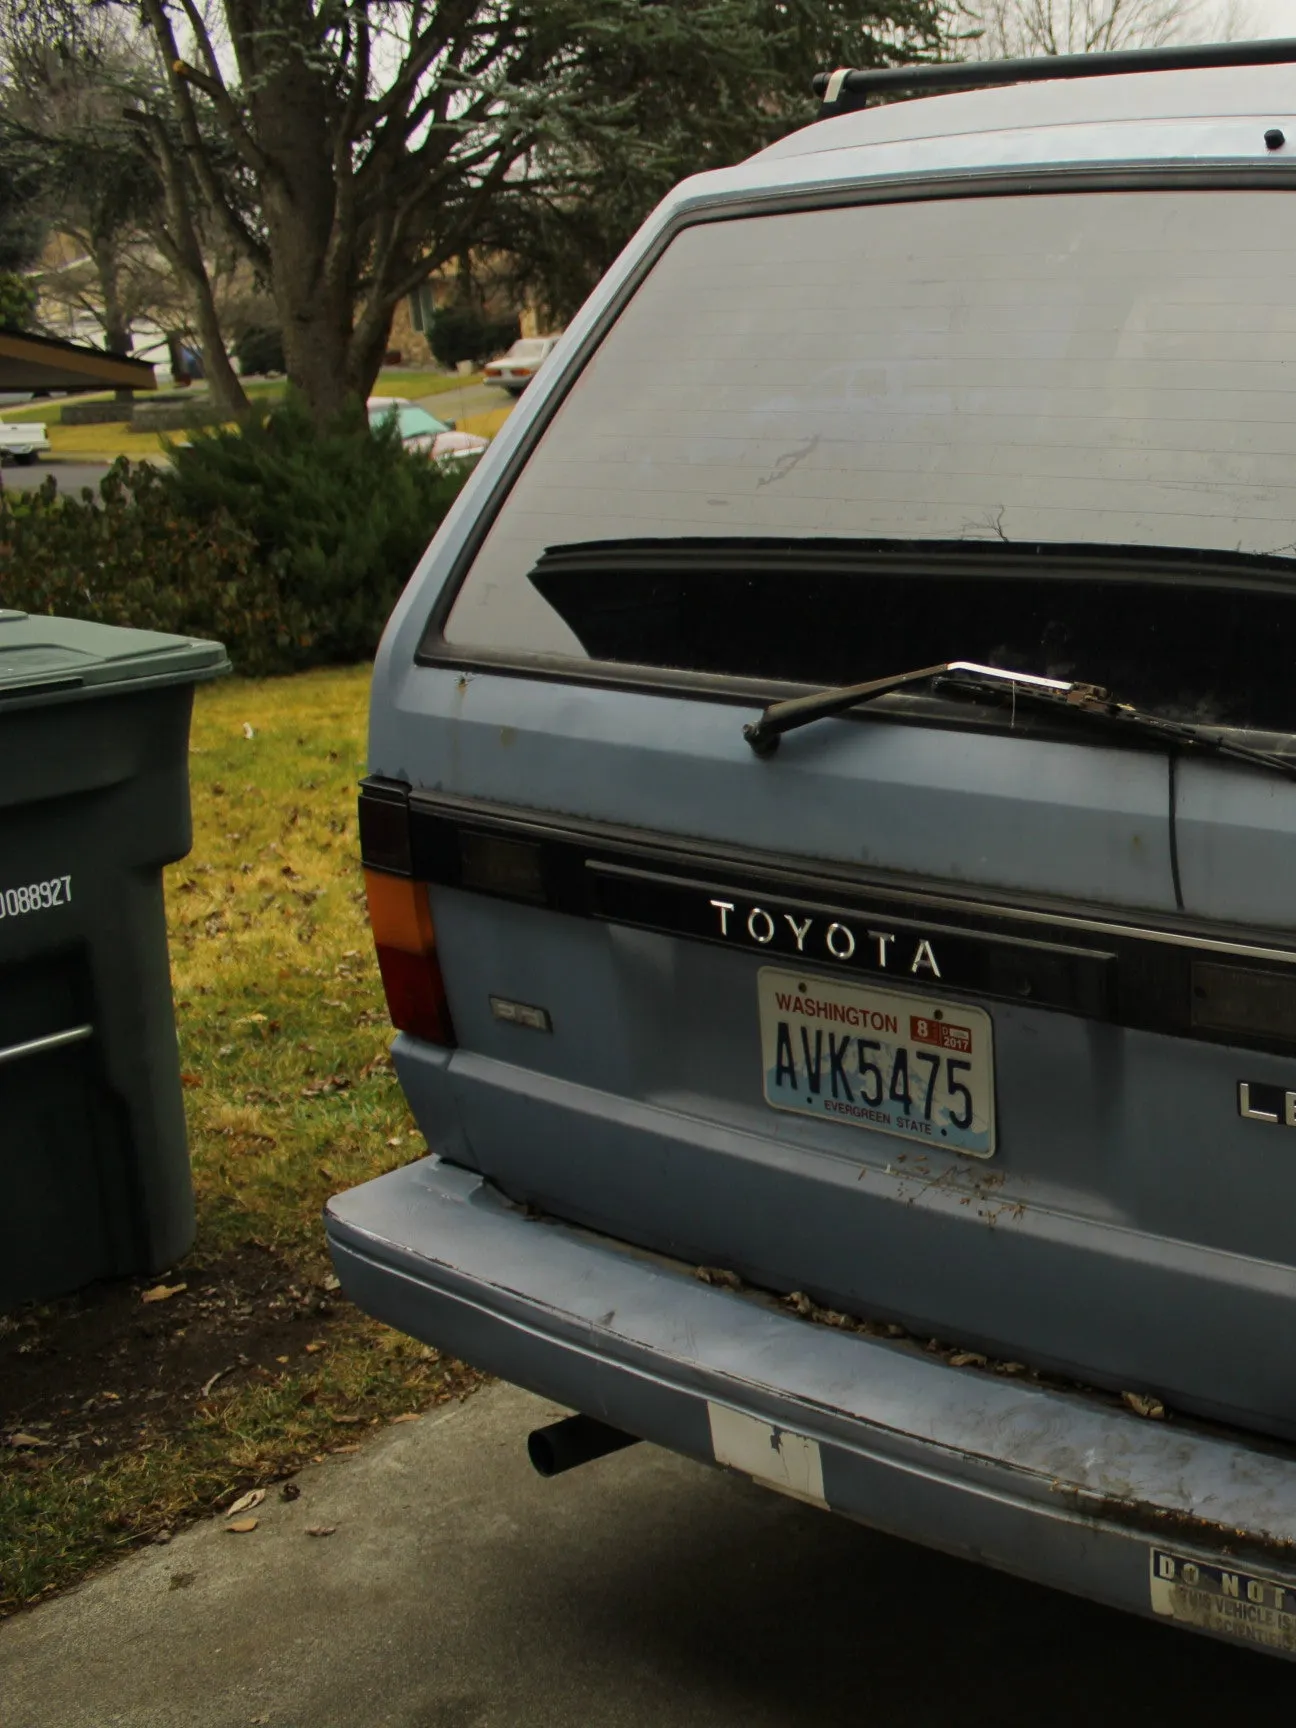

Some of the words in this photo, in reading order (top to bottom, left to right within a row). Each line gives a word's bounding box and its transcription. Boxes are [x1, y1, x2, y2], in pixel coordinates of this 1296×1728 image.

[710, 900, 941, 978] TOYOTA
[775, 992, 898, 1033] WASHINGTON
[917, 1020, 928, 1038] 8
[943, 1036, 969, 1051] 2017
[775, 1021, 974, 1130] AVK5475
[824, 1100, 891, 1124] EVERGREEN
[896, 1117, 932, 1135] STATE
[1159, 1554, 1200, 1586] DO
[1222, 1572, 1286, 1610] NOT
